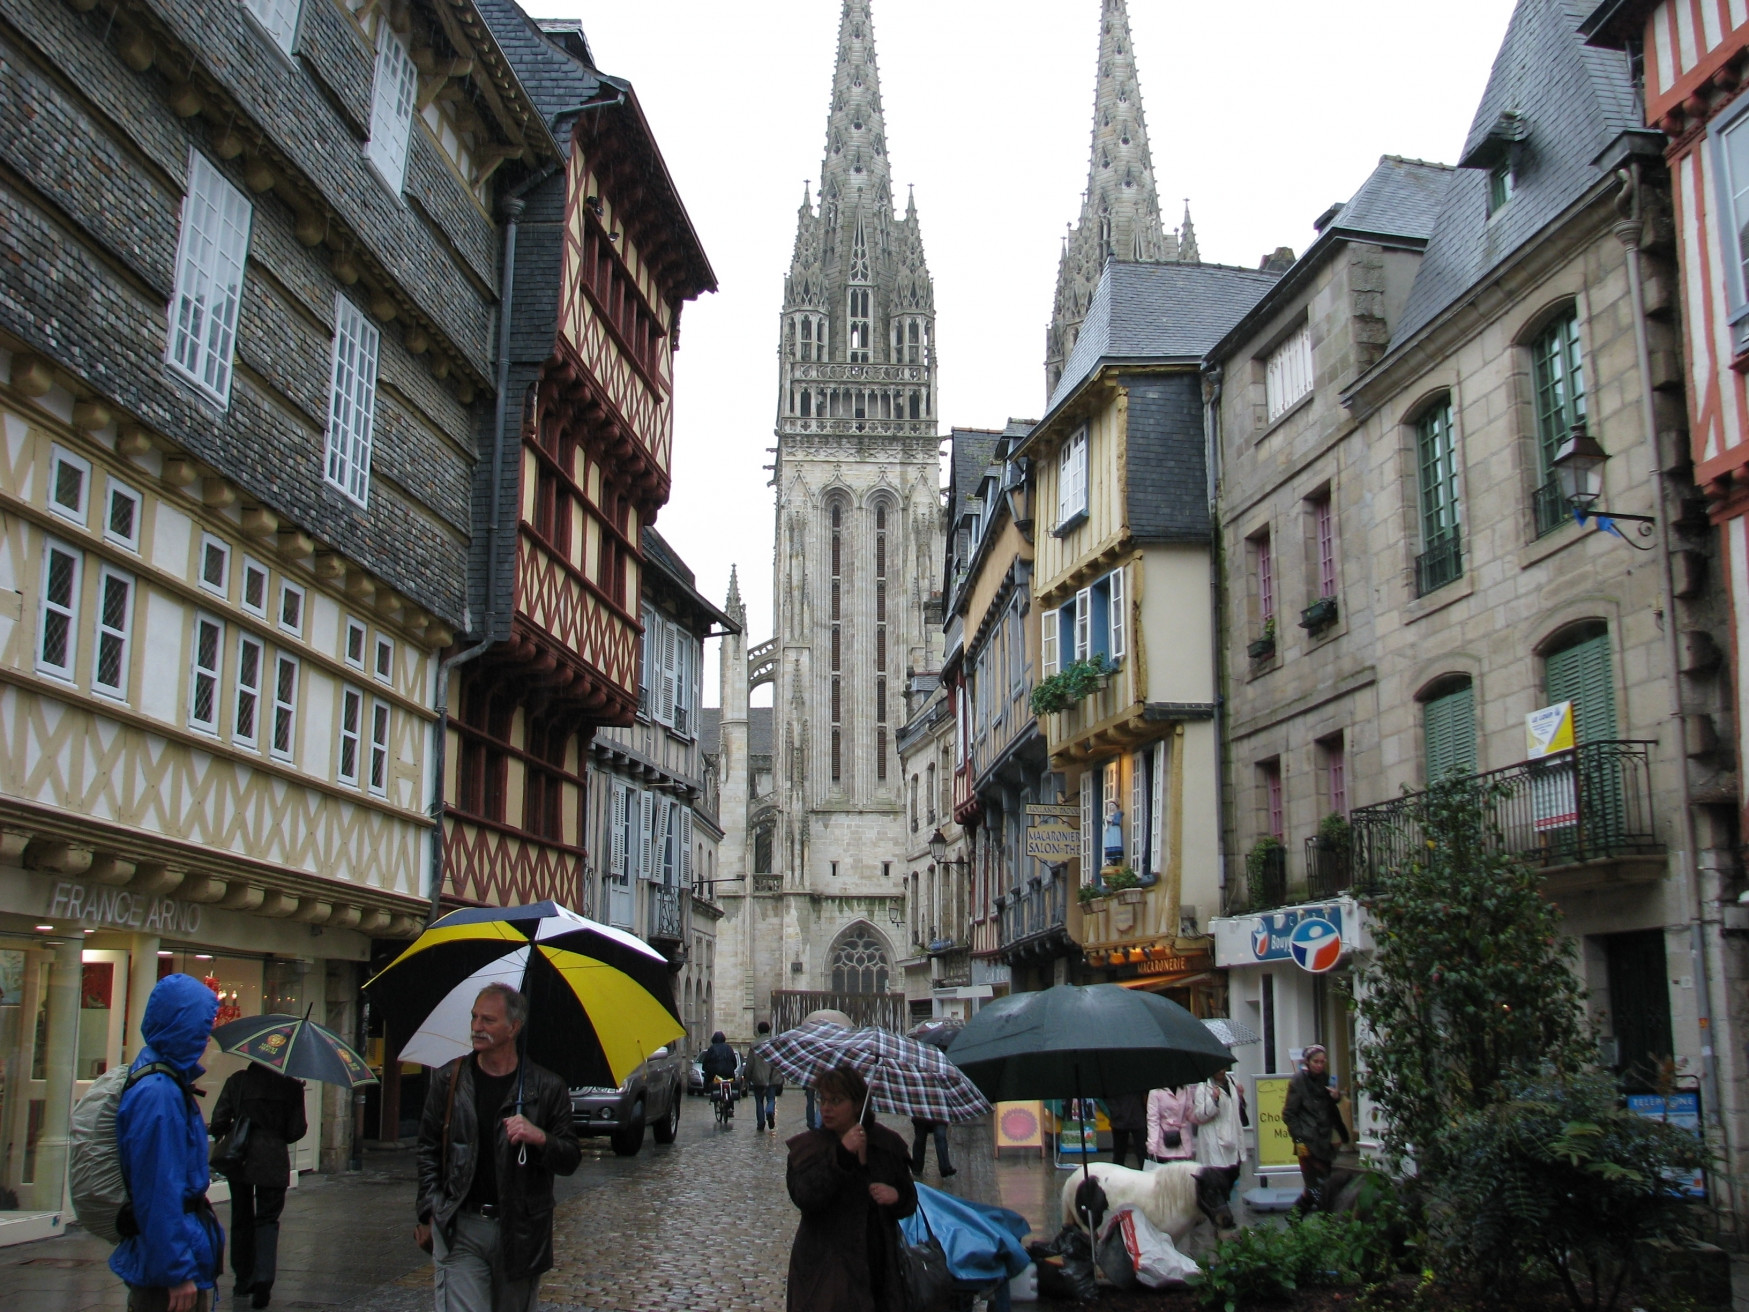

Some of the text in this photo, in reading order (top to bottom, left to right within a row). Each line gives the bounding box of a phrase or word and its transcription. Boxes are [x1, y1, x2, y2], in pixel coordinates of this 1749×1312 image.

[1028, 842, 1060, 854] SALON
[51, 882, 201, 933] FRANCE ARNO
[1137, 957, 1186, 974] MACARONERIE
